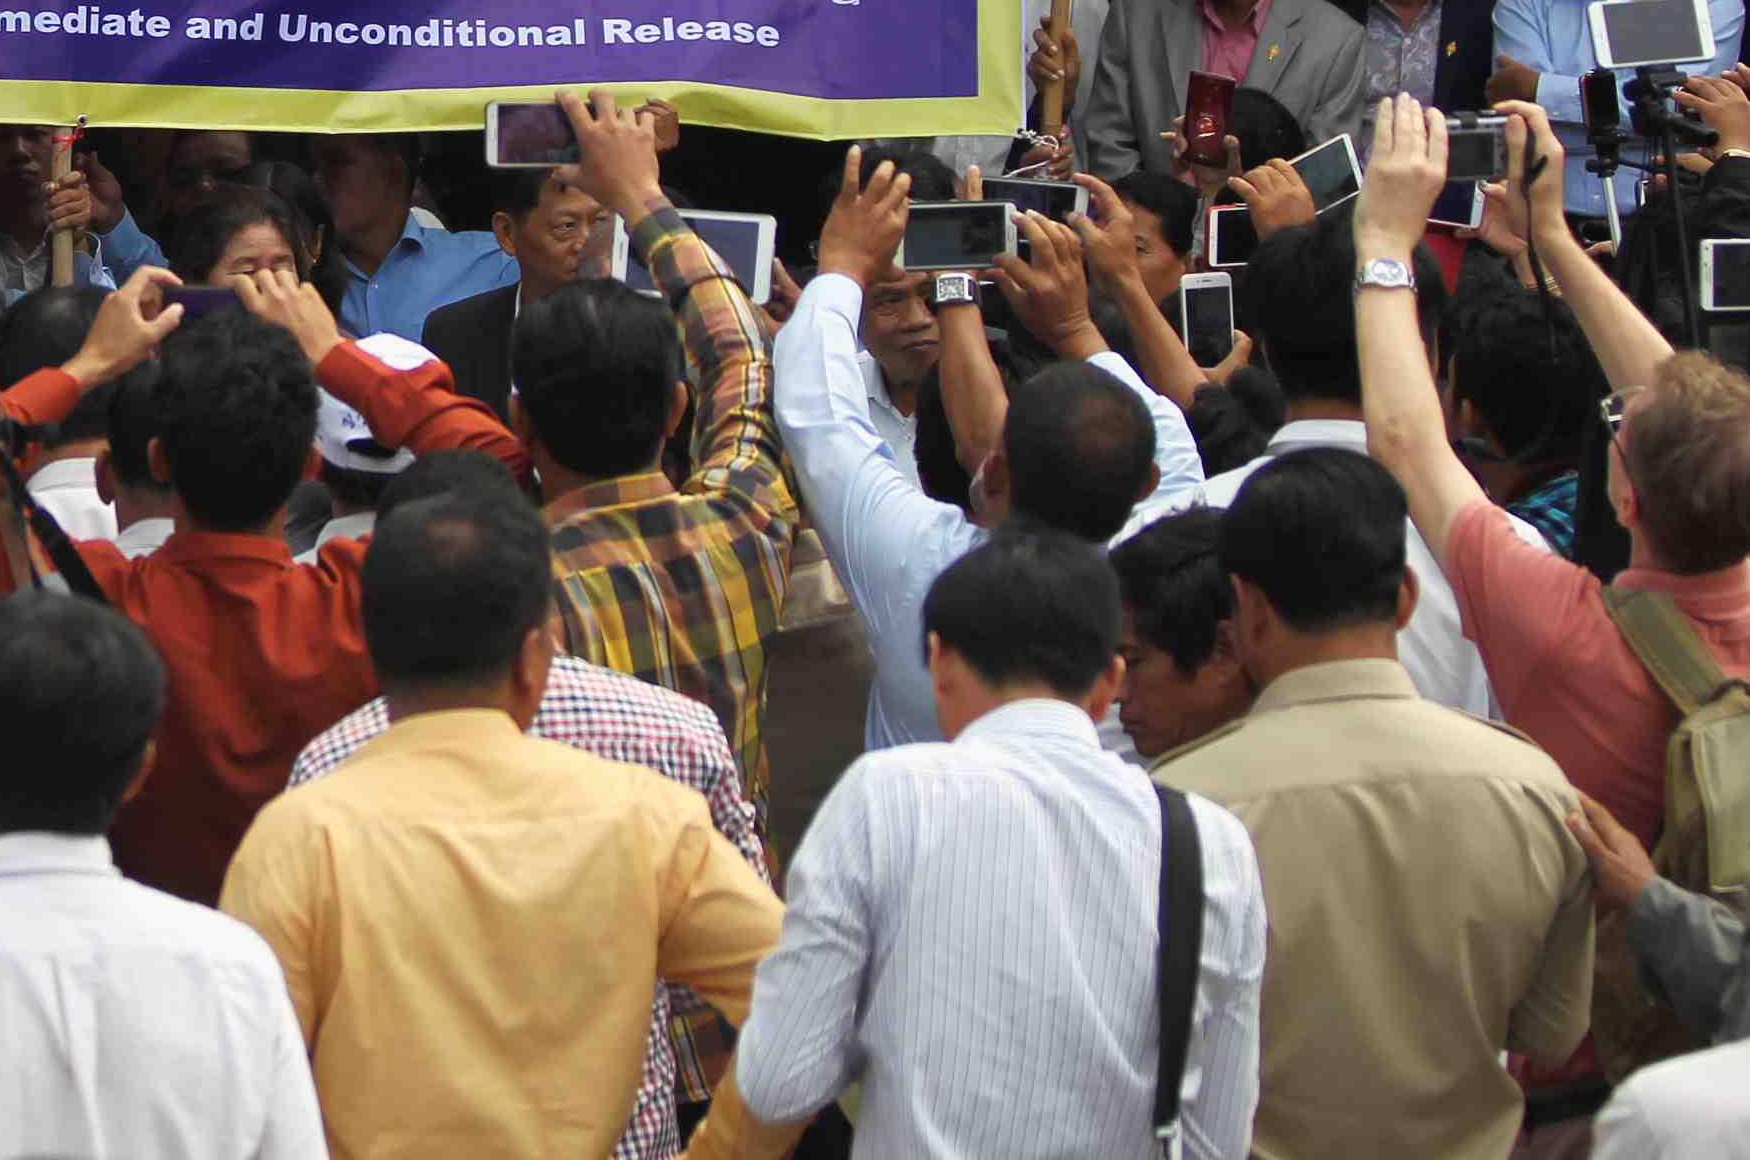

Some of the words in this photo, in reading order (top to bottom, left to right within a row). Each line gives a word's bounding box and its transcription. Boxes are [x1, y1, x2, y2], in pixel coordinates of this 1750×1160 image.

[185, 13, 264, 41] and
[278, 14, 587, 48] Unconditional
[602, 17, 780, 47] Release
